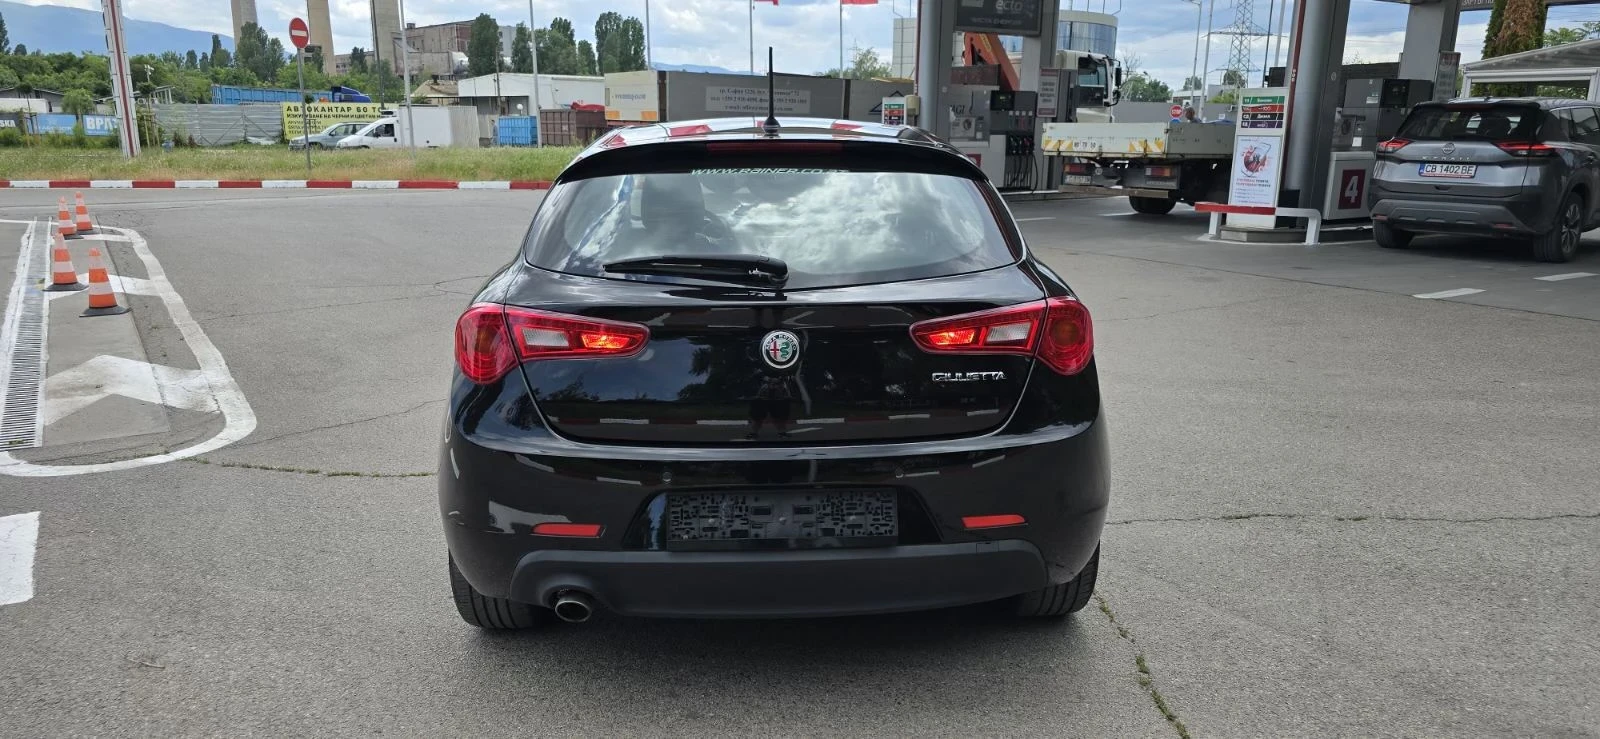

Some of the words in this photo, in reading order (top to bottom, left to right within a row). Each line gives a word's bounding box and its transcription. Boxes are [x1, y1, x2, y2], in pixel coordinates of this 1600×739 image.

[286, 105, 352, 113] АВОКАНТАР
[1425, 164, 1437, 173] CB
[1440, 165, 1460, 174] 1402
[1461, 165, 1474, 175] BE
[1344, 175, 1359, 203] 4
[932, 371, 1007, 382] GIULIETTA
